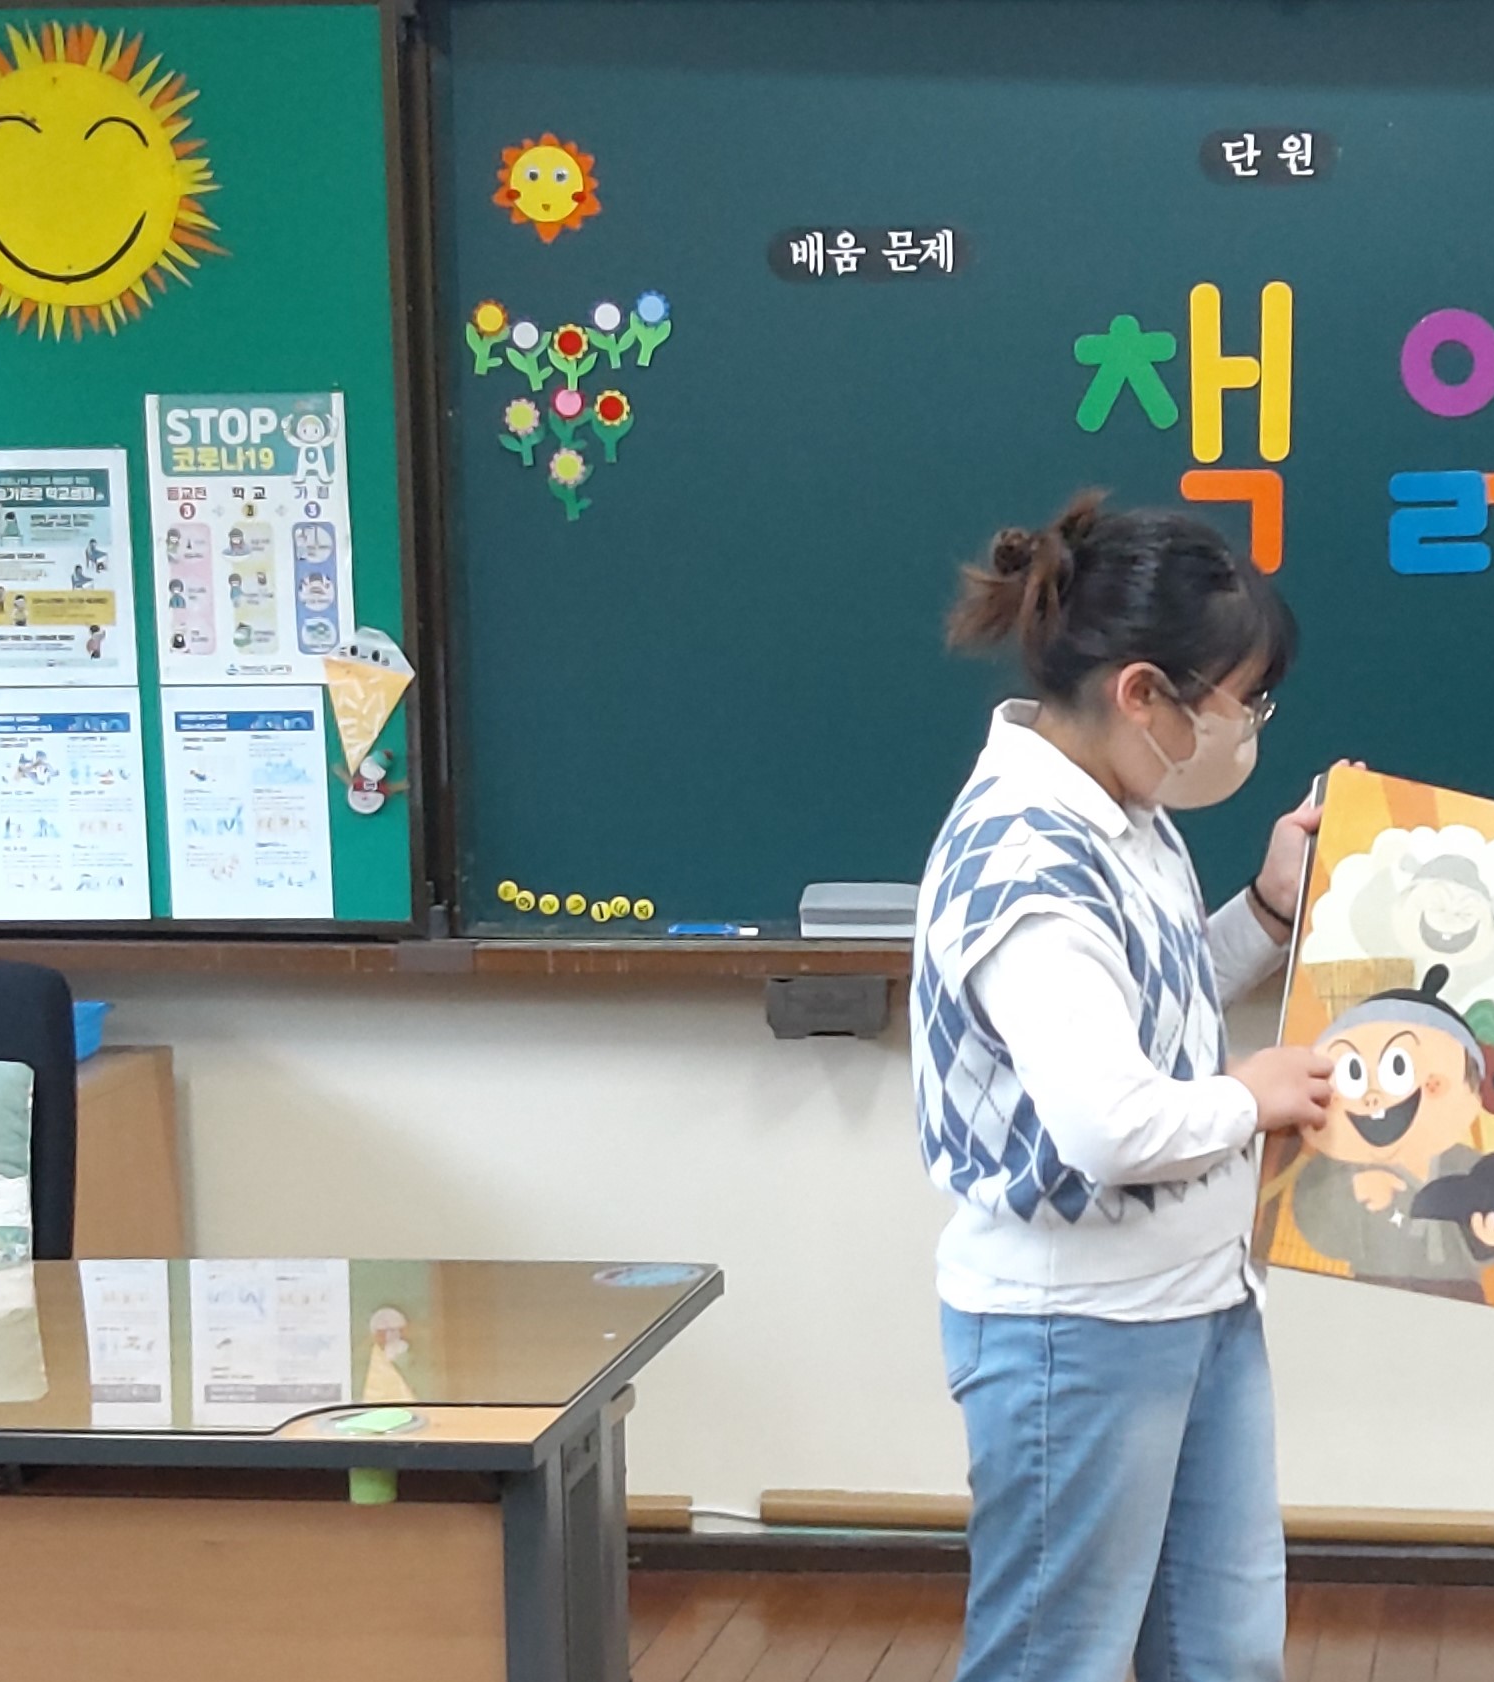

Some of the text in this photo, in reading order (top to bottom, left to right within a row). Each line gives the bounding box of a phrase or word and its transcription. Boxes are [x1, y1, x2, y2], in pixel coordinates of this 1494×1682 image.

[790, 229, 955, 276] 배움 문제
[166, 407, 278, 445] STOP
[1073, 280, 1294, 575] 책
[173, 446, 274, 471] 코로나19
